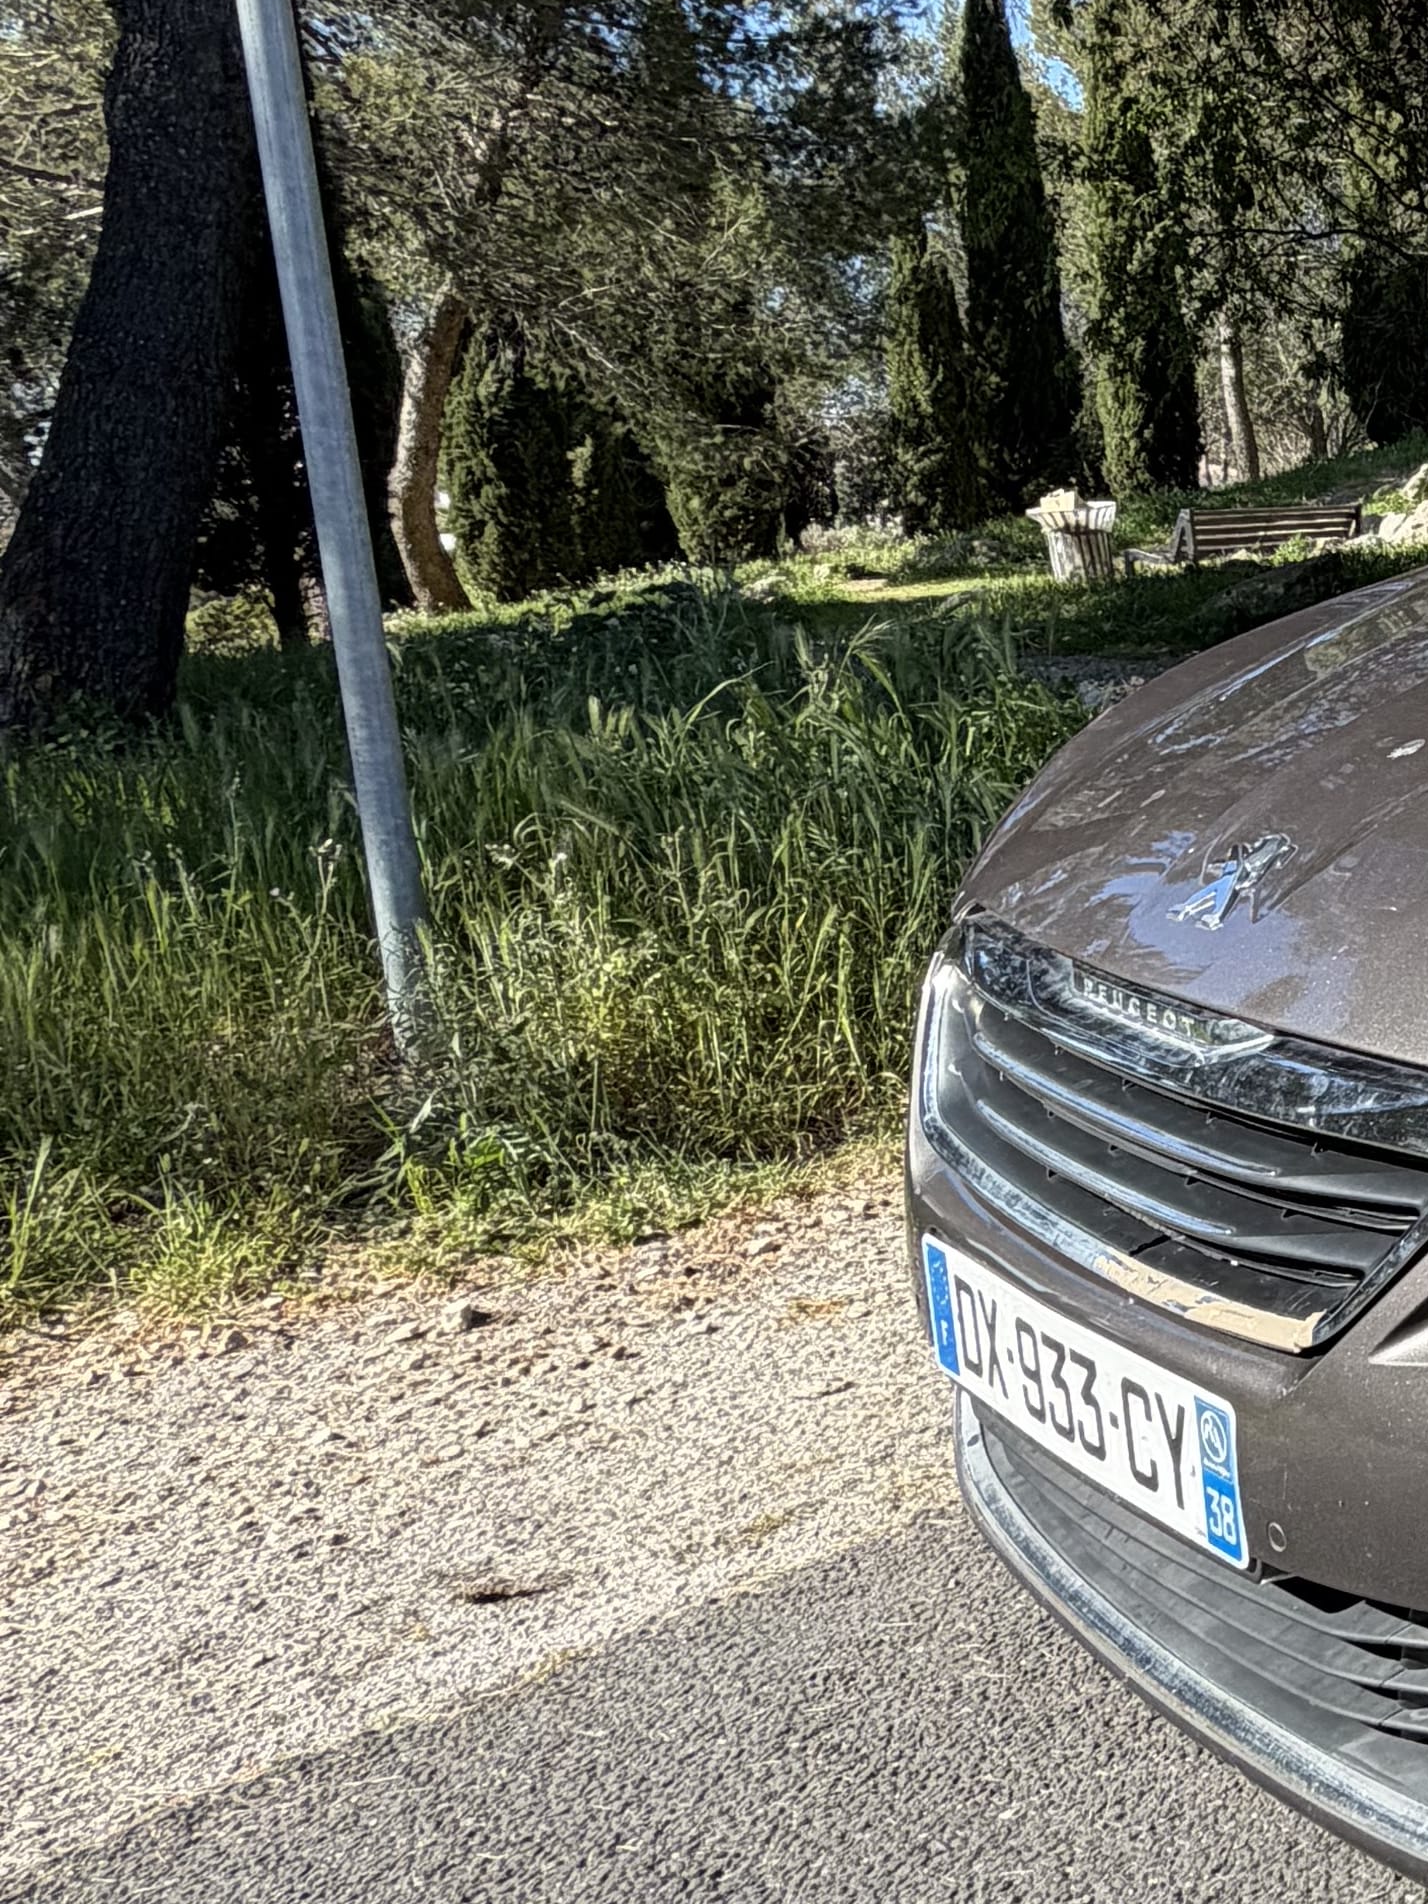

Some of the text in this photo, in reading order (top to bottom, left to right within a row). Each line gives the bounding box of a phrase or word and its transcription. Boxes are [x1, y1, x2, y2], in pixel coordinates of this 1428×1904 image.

[1083, 977, 1195, 1037] PEUGEOT
[954, 1275, 1186, 1510] DX-933-CY
[1206, 1486, 1237, 1545] 38
